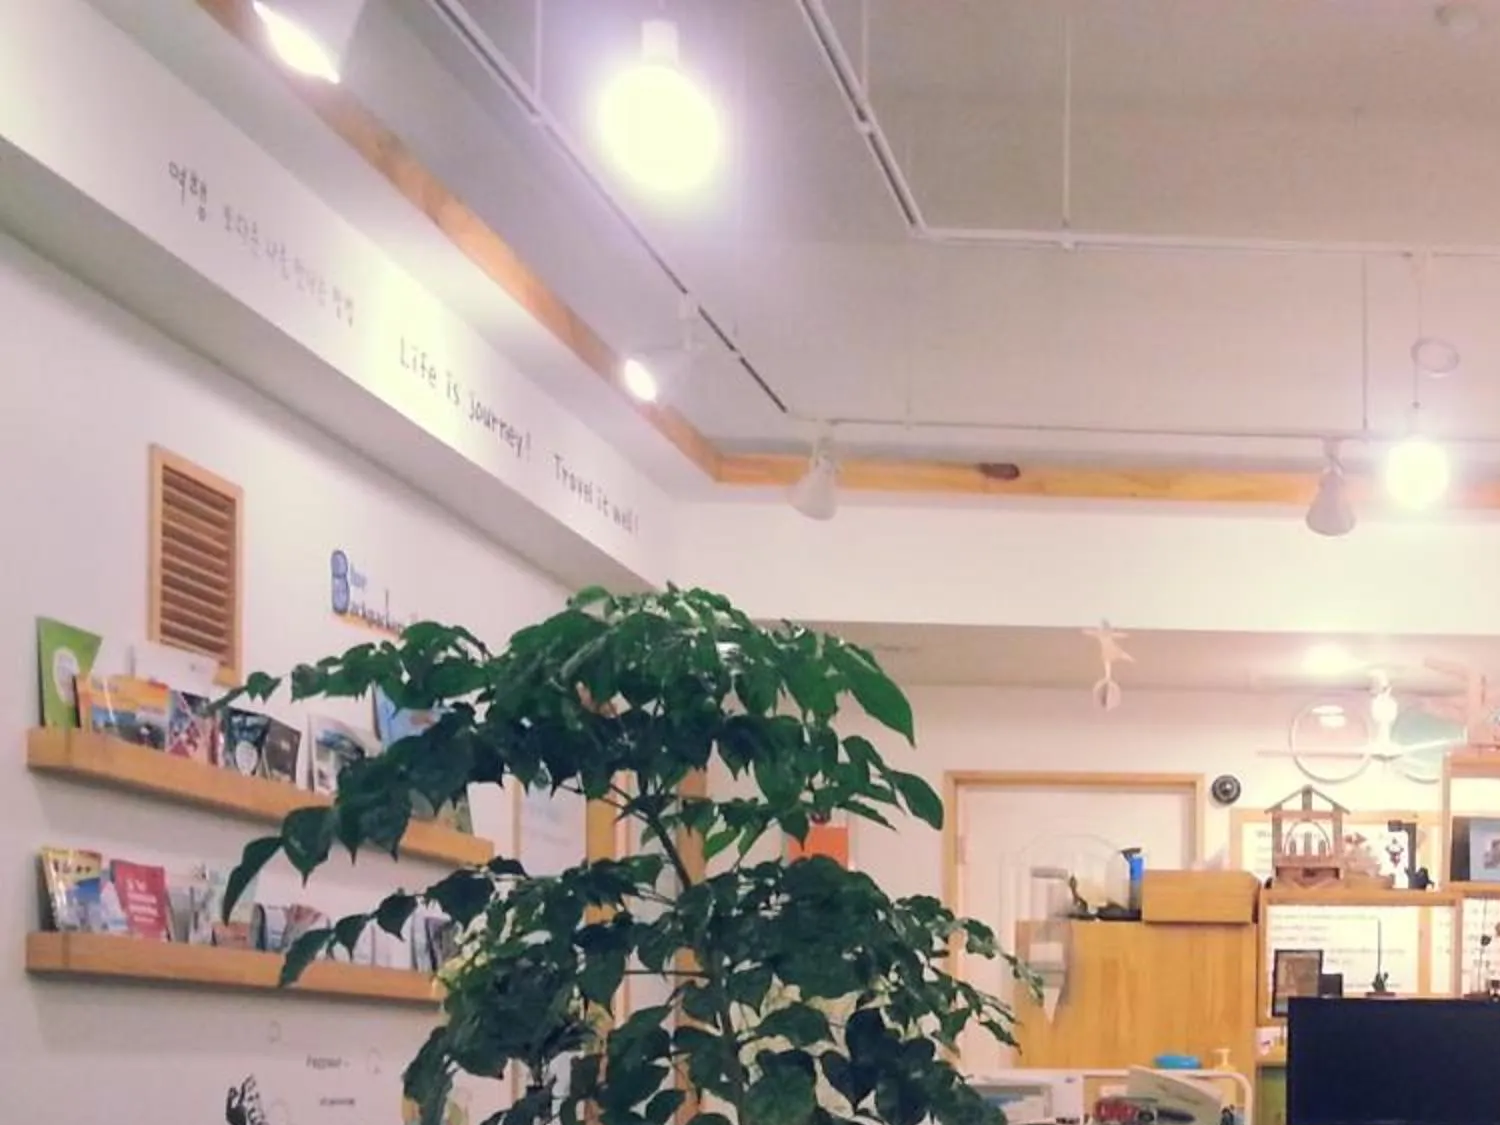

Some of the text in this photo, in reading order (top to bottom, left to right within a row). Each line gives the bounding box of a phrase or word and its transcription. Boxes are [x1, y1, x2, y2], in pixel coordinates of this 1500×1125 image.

[168, 160, 207, 222] 여행
[400, 336, 437, 389] Life
[446, 370, 461, 406] is
[554, 453, 593, 505] Travel
[598, 487, 609, 517] it
